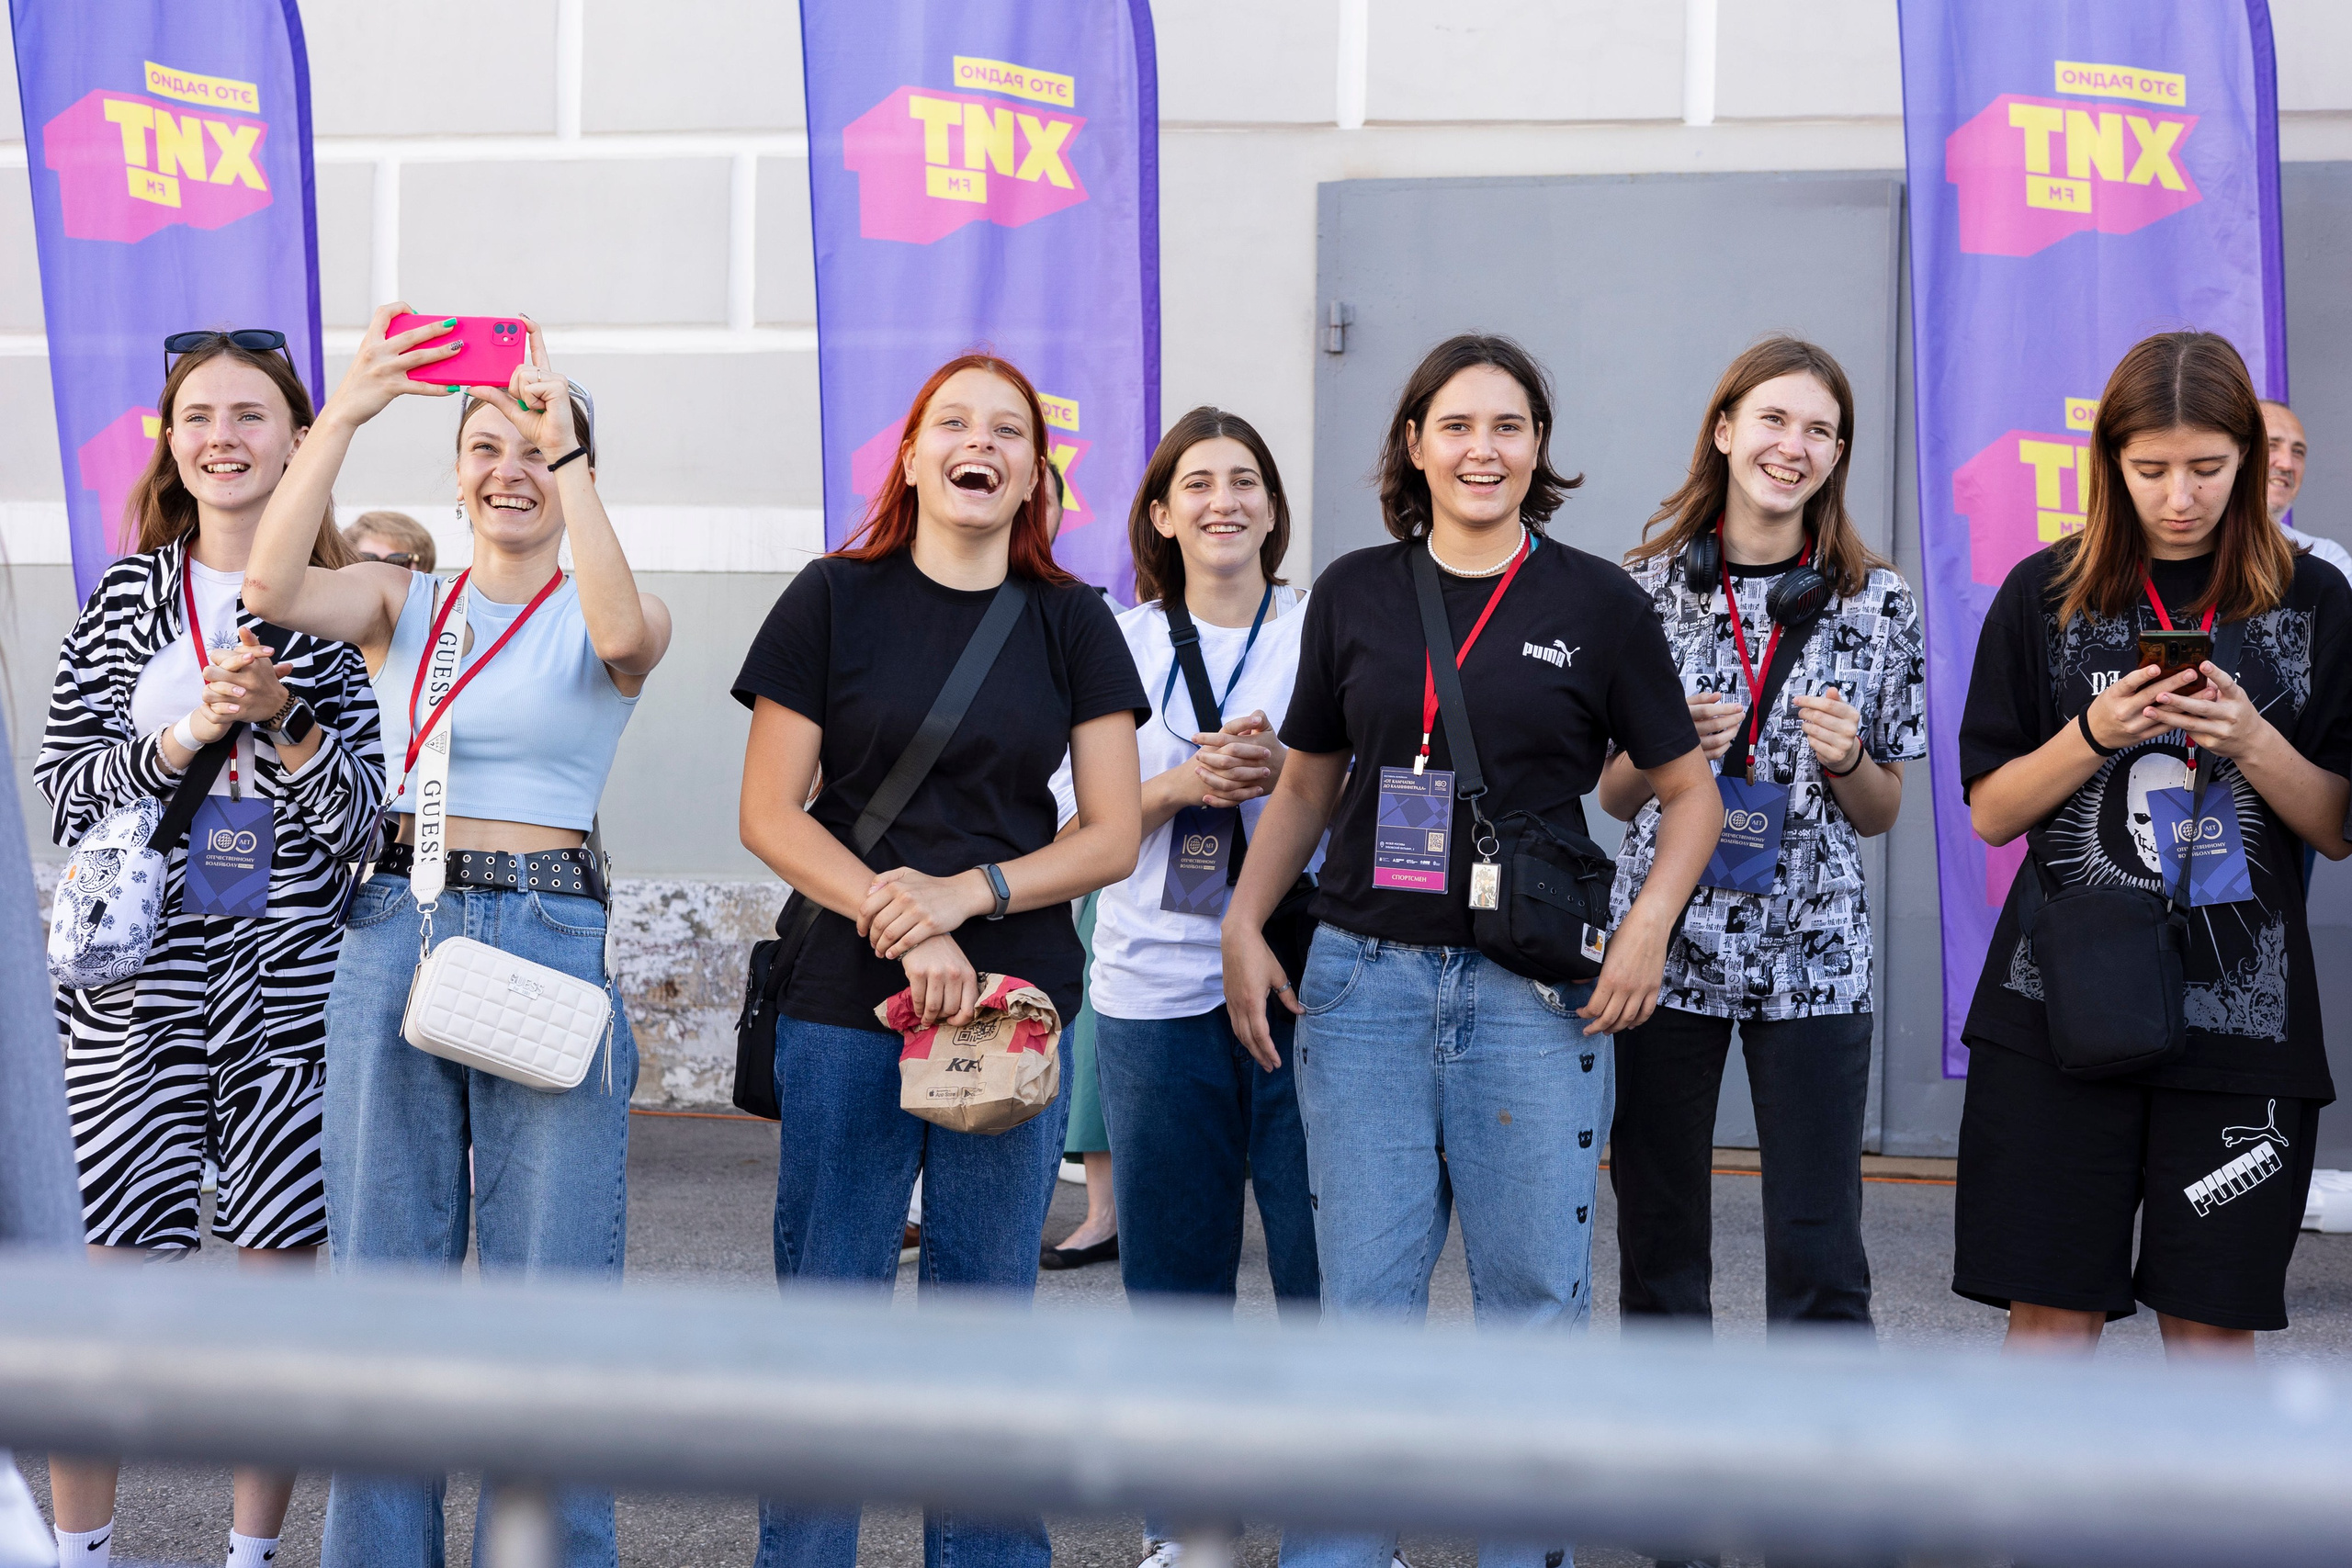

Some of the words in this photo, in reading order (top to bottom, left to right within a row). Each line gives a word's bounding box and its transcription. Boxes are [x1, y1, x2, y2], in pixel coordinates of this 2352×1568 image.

[429, 632, 458, 706] GUESS
[1522, 641, 1566, 668] PUMA
[421, 780, 442, 862] GUES
[1391, 874, 1427, 883] СПОРТСМЕН
[509, 973, 545, 996] GUESS
[2184, 1141, 2282, 1217] PUMA
